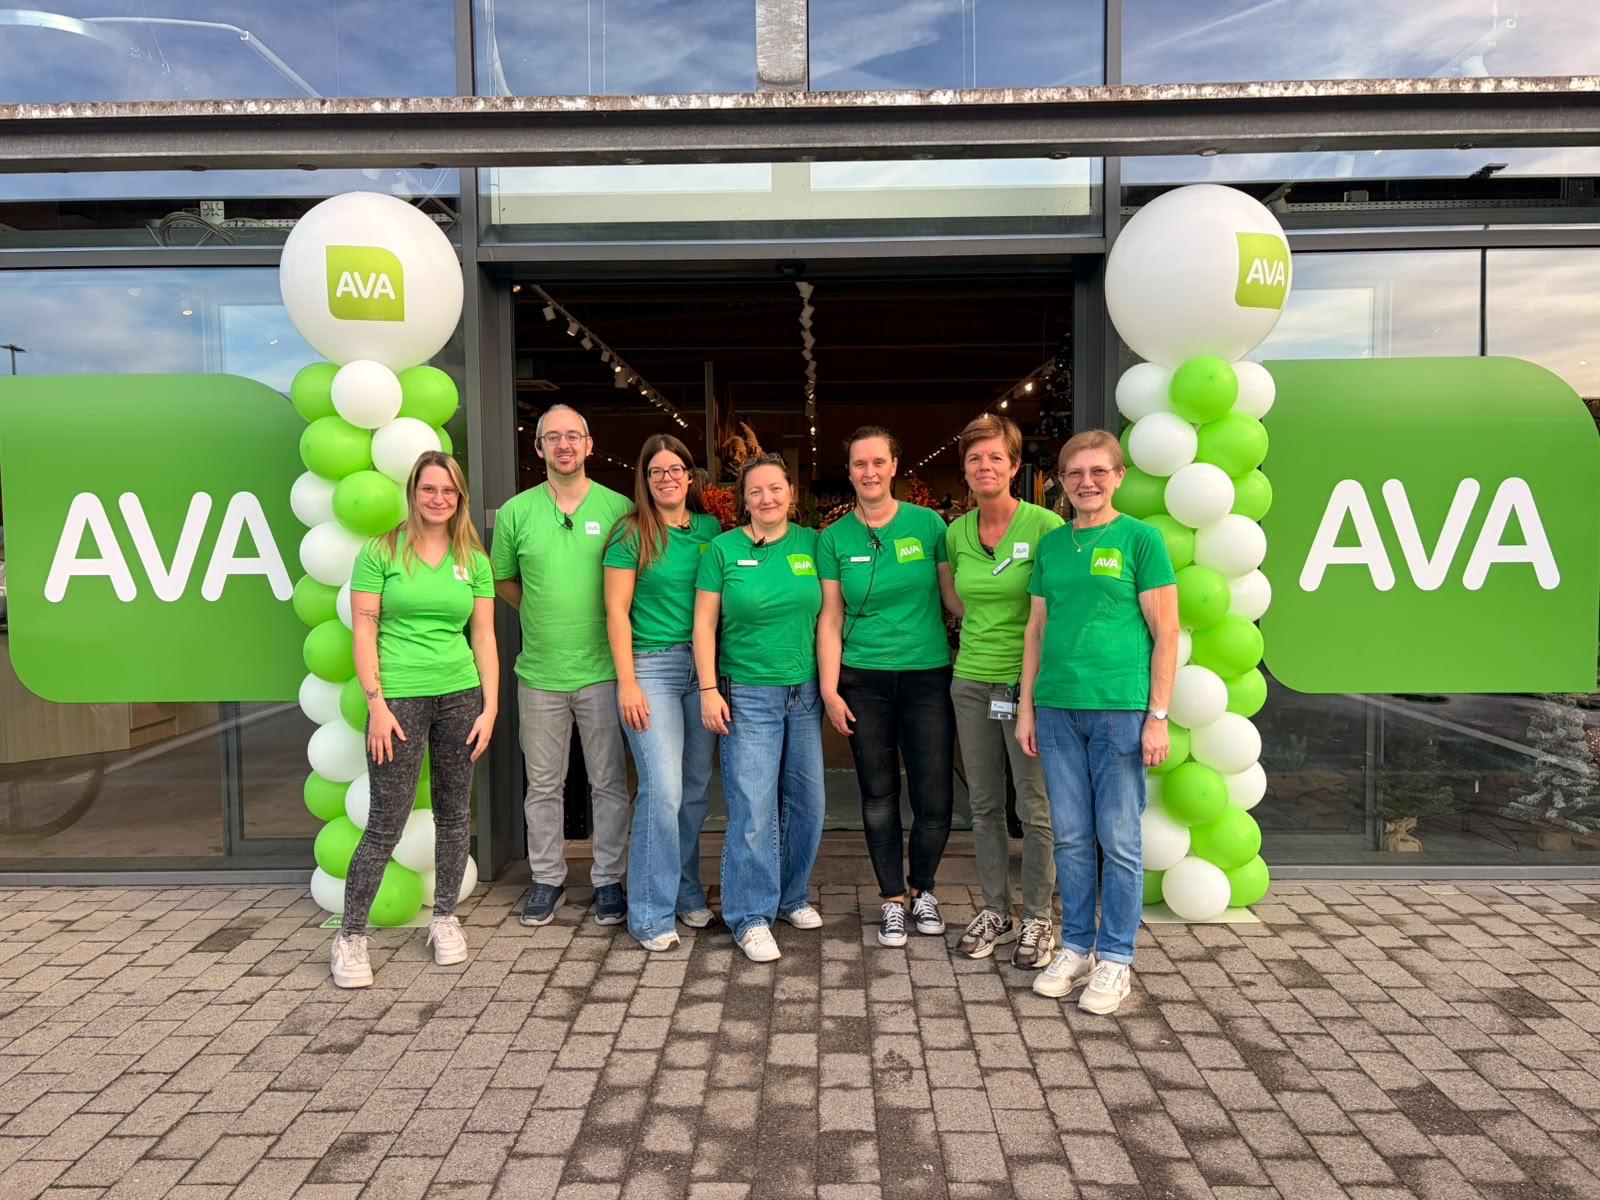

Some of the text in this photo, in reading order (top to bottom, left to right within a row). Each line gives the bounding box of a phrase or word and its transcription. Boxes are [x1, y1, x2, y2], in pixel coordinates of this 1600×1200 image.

[336, 271, 396, 300] AVA
[1246, 257, 1286, 288] AVA
[44, 491, 295, 603] AVA
[1299, 477, 1560, 592] AVA
[900, 545, 920, 557] AVA
[1094, 557, 1119, 569] AVA
